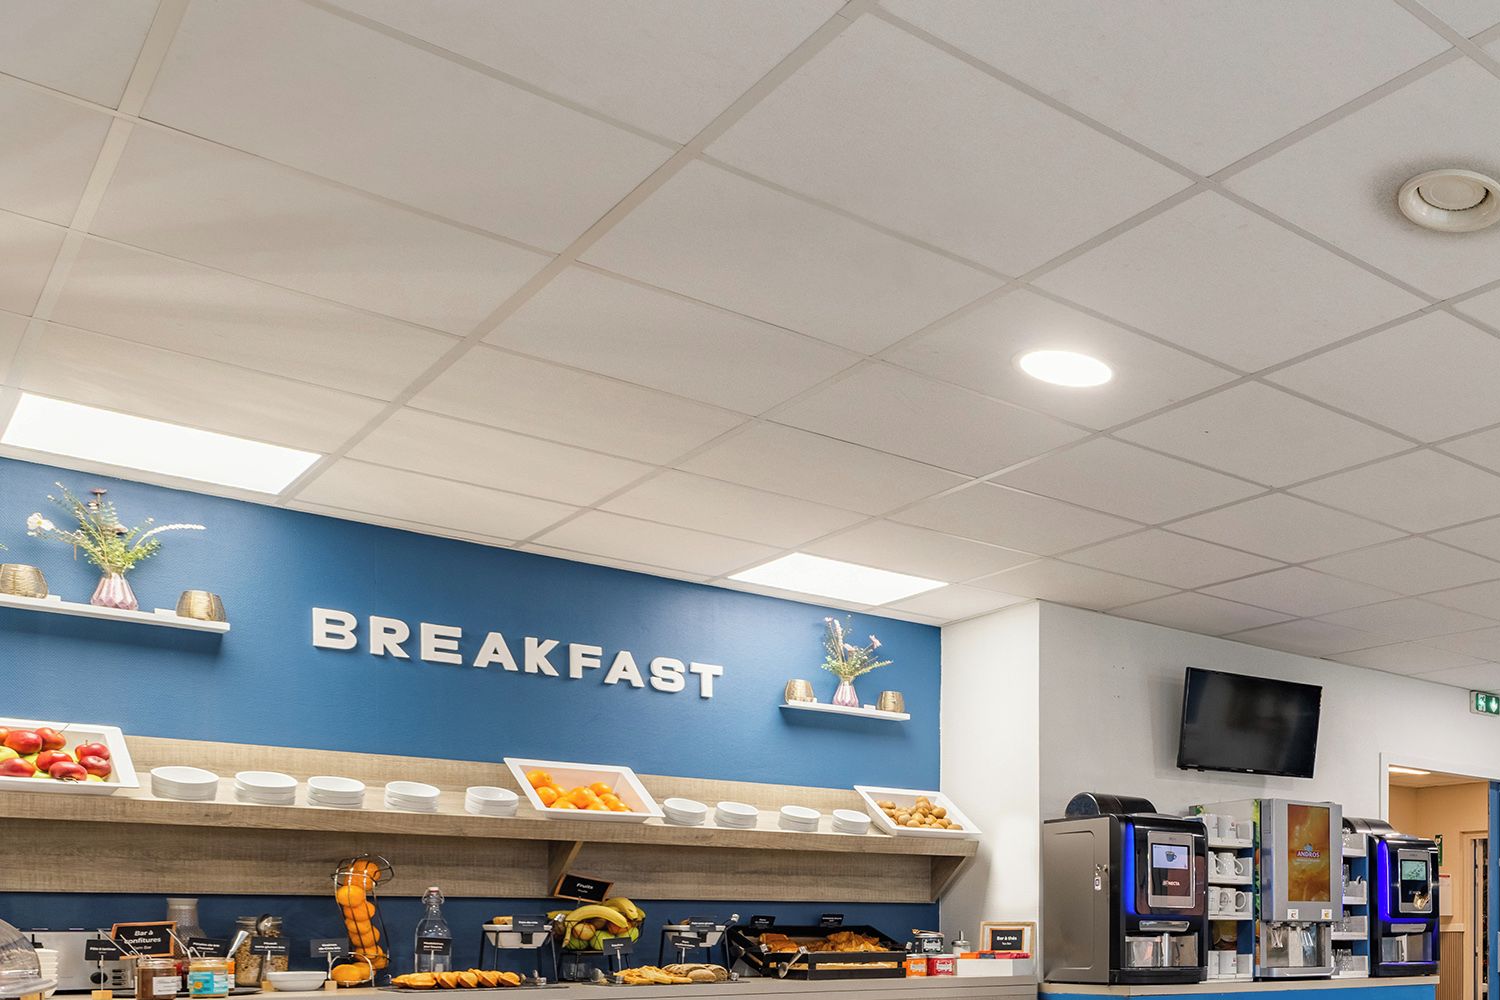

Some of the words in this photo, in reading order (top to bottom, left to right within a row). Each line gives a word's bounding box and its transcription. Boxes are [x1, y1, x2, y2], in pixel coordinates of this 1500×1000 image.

[311, 606, 724, 699] BREAKFAST
[1296, 850, 1320, 858] ANDROS
[576, 882, 594, 890] Fruits
